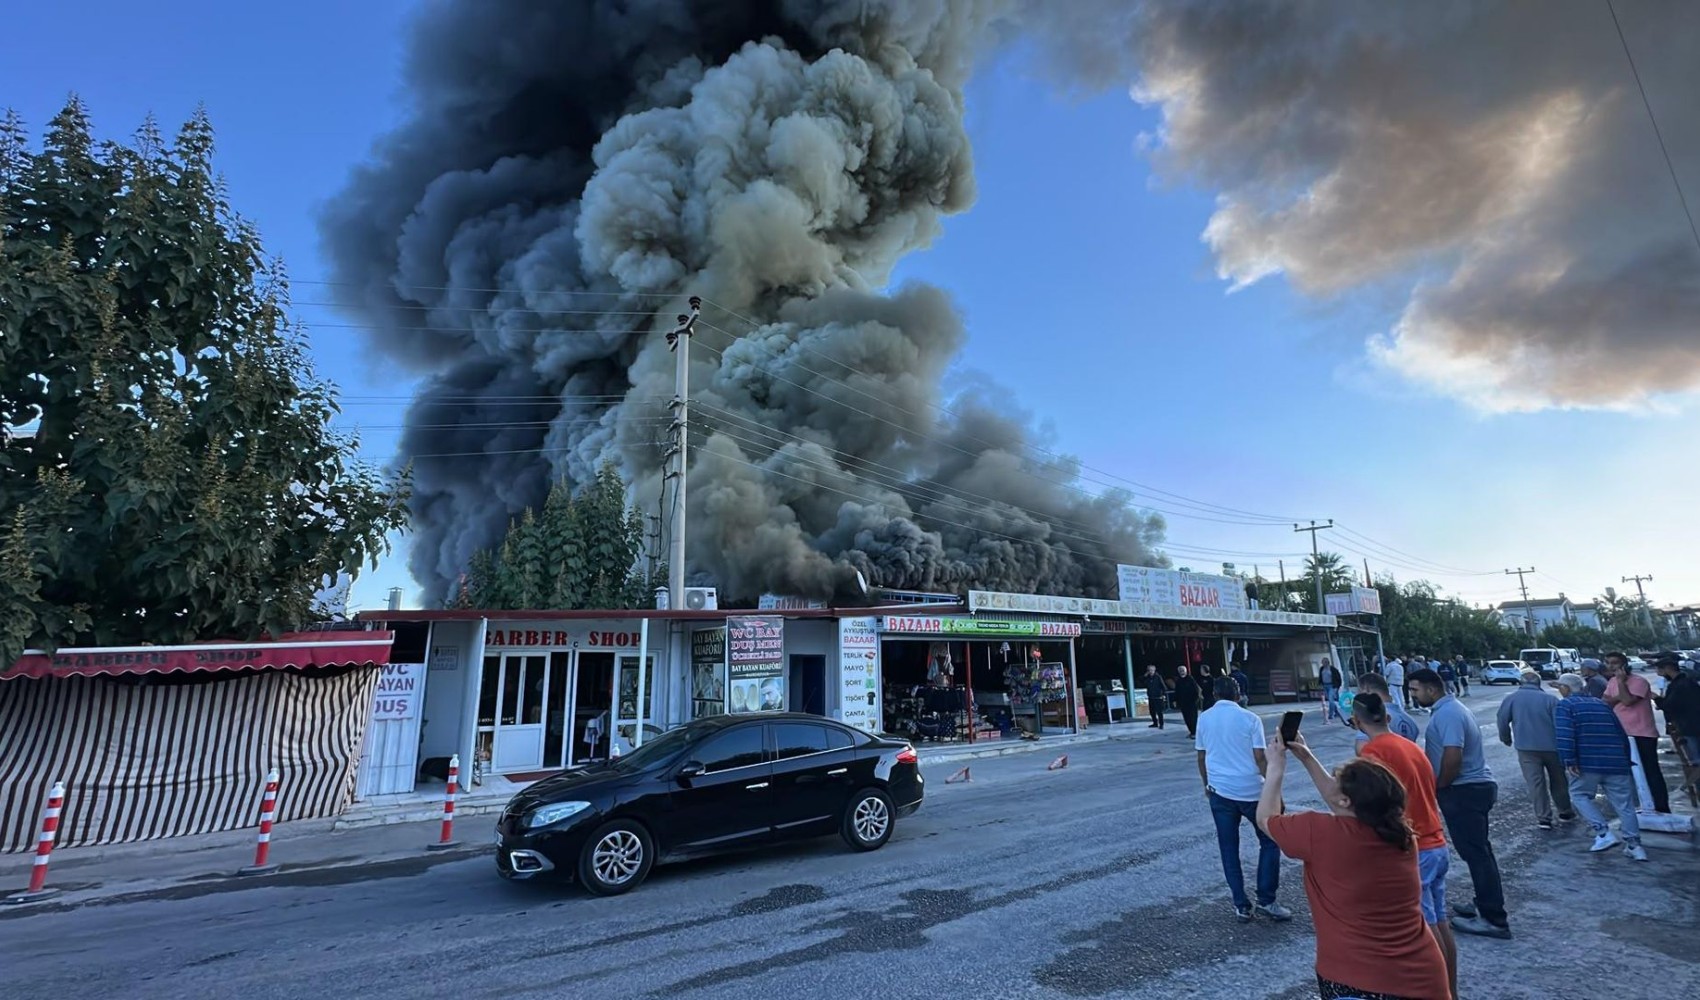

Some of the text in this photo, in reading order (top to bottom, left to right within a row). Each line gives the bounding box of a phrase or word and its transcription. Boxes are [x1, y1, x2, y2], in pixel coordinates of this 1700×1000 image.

[1179, 584, 1220, 608] BAZAAR
[852, 619, 867, 627] ÖZEL
[889, 617, 941, 632] BAZAAR
[730, 627, 781, 638] WC BAY
[1041, 623, 1080, 636] BAZAAR
[843, 636, 876, 644] BAZAAR
[380, 664, 409, 676] WC
[377, 677, 414, 691] AYAN
[844, 710, 865, 718] ÇANTA
